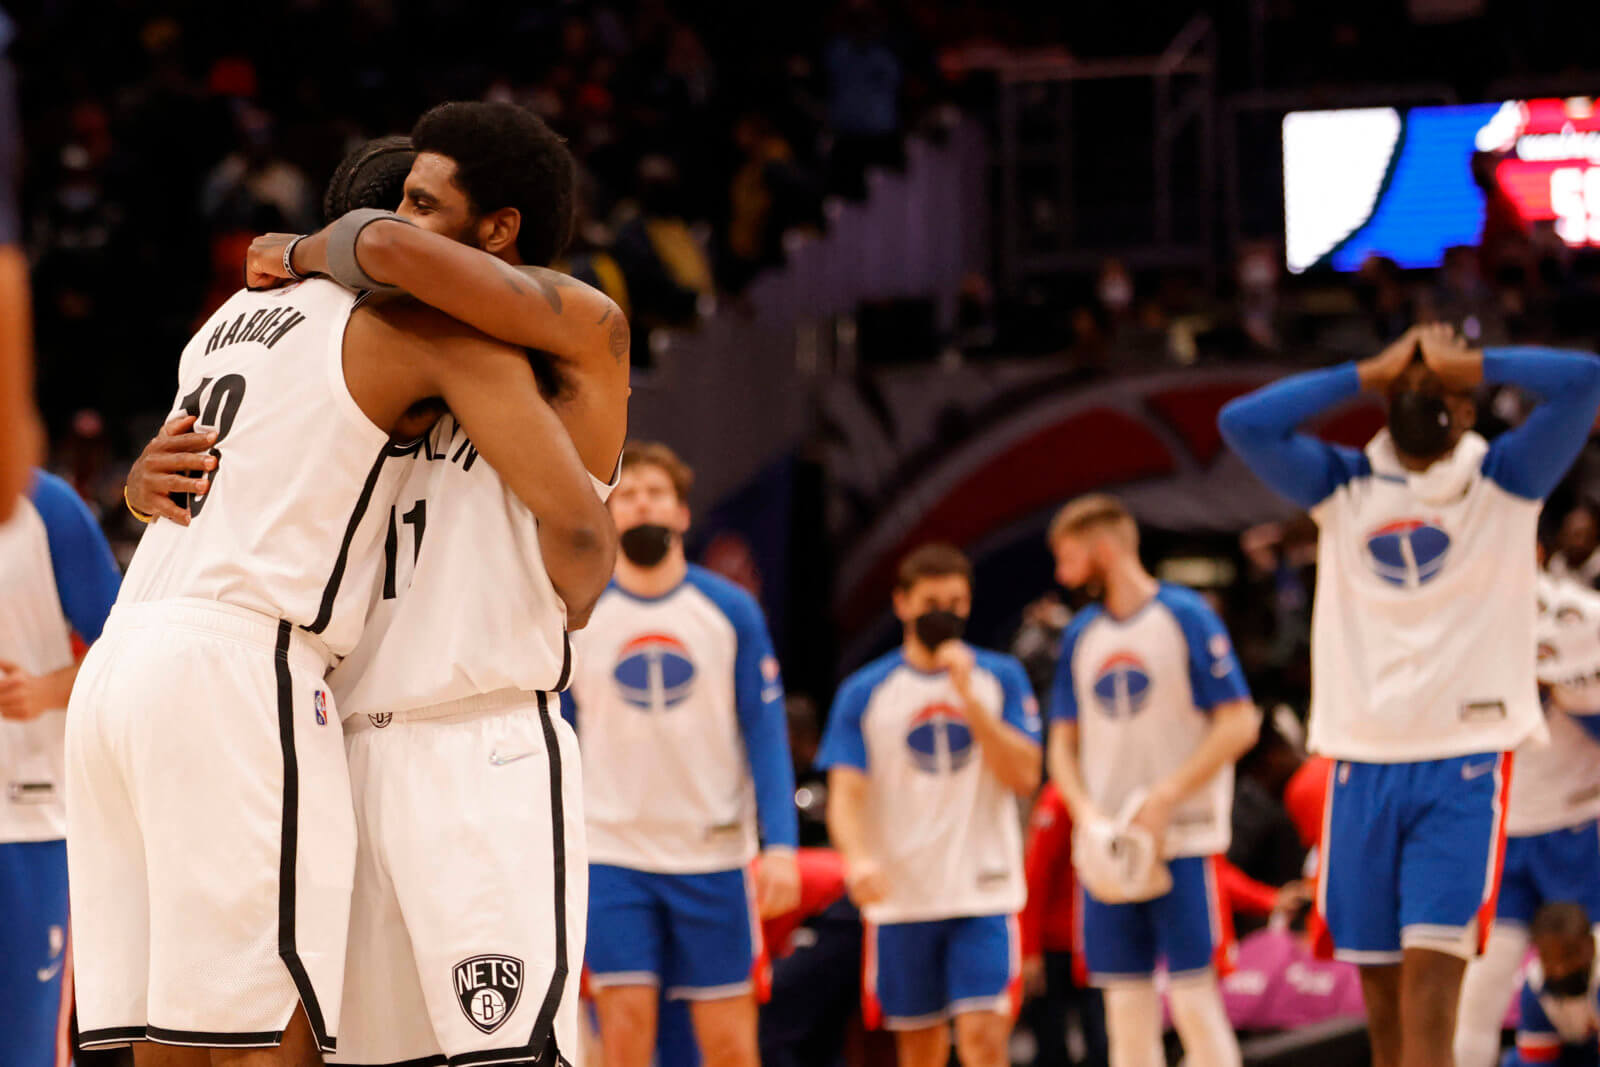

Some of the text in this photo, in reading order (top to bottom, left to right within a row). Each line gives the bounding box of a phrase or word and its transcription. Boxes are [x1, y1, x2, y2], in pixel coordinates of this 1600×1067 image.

[204, 306, 306, 357] HARDEN
[383, 499, 427, 600] 11
[457, 959, 519, 996] NETS
[482, 993, 495, 1021] B
